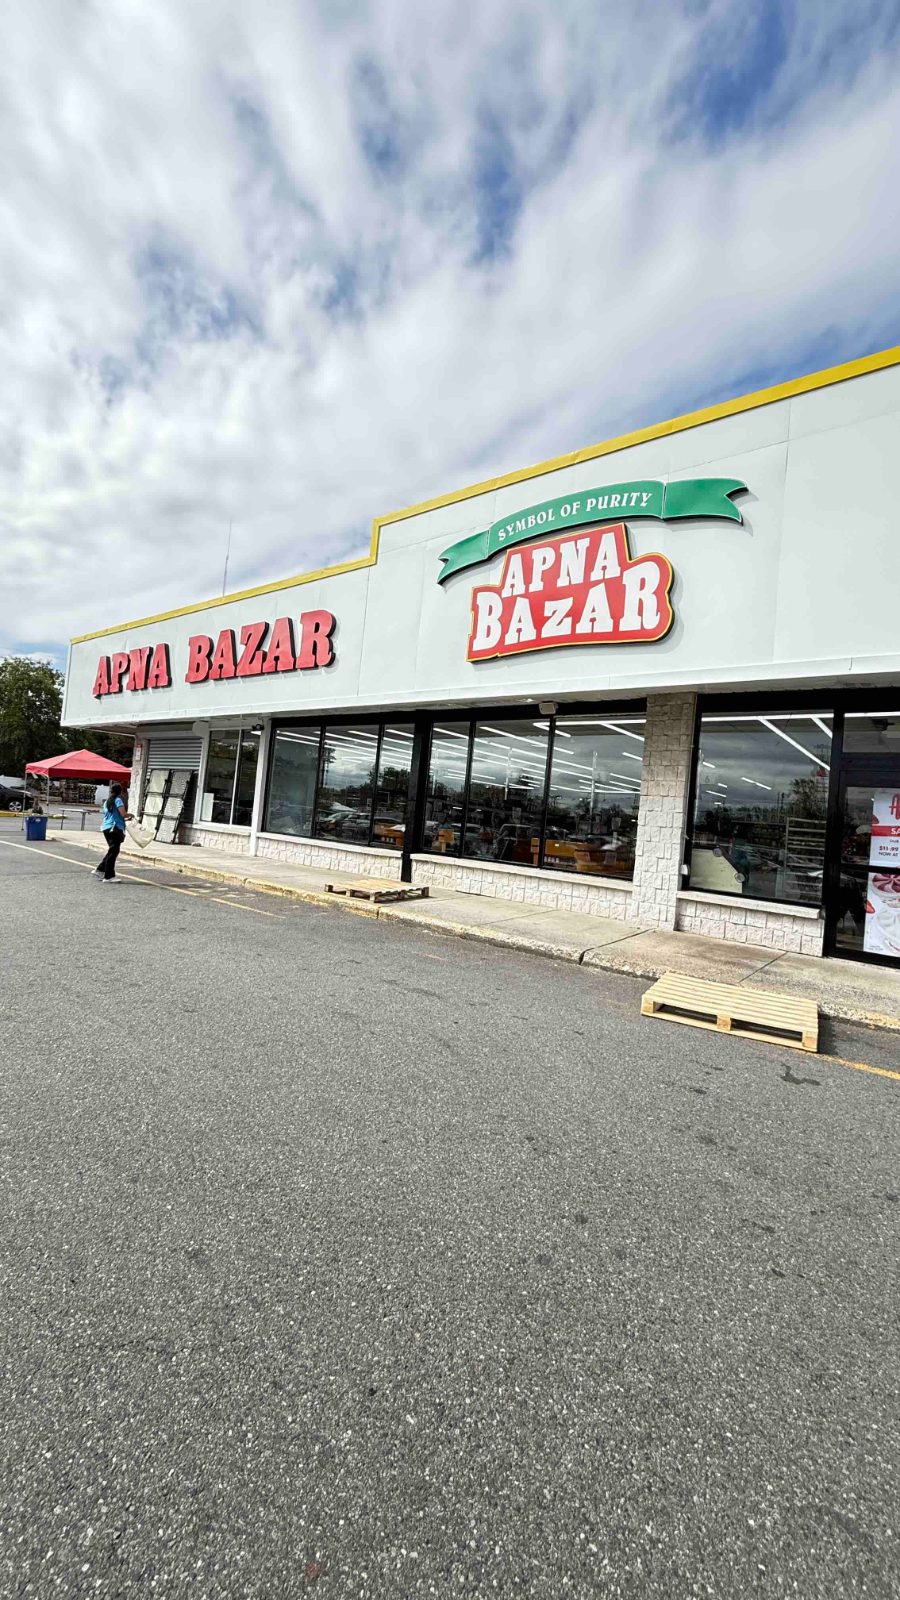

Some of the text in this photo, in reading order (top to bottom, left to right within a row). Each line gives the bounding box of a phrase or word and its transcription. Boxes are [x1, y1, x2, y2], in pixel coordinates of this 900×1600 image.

[498, 492, 652, 541] SYMBOL OF PURITY
[502, 532, 621, 598] APNA
[472, 561, 661, 651] BAZAR
[92, 609, 336, 695] APNA BAZAR
